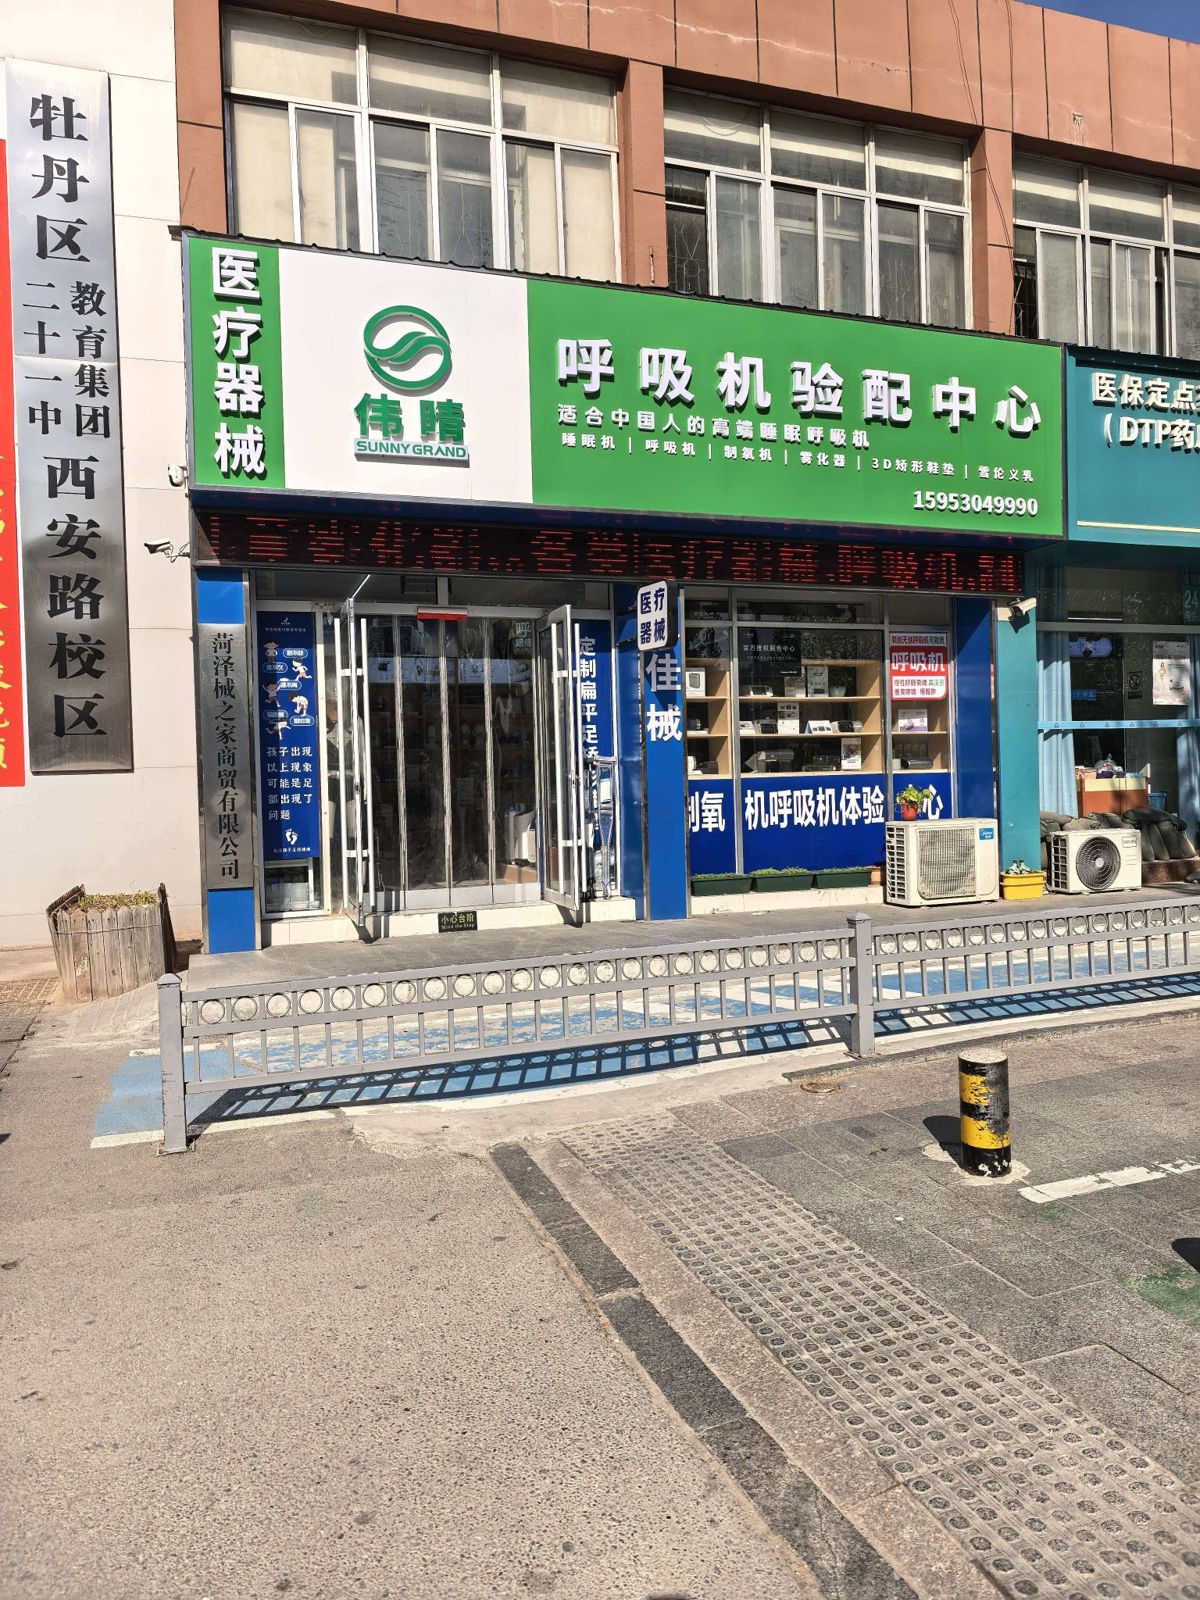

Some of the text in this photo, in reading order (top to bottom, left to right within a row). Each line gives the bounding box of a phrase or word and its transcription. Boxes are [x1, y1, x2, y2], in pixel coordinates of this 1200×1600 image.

[28, 93, 91, 263] 牡丹区
[22, 281, 63, 437] 二十一中
[70, 280, 111, 439] 教育集团
[211, 246, 267, 475] 医疗器械
[557, 337, 1042, 435] 呼吸机验配中心
[1092, 371, 1200, 414] 医保定点
[353, 392, 466, 444] 伟晴
[558, 403, 870, 450] 适合中国人的高端睡眠呼吸机
[1104, 413, 1200, 452] (DTP药
[356, 440, 467, 459] SUNNY GRAND
[645, 439, 696, 457] 呼吸机
[724, 445, 773, 462] 制氧机
[913, 490, 1039, 517] 15953049990
[43, 454, 108, 738] 西安路校区
[640, 587, 666, 615] 医疗
[640, 618, 666, 645] 器械
[891, 651, 945, 672] 呼吸机
[210, 631, 240, 881] 菏泽械之家商贸有限公司
[266, 746, 313, 758] 孩子出现
[267, 762, 313, 773] 以上现象
[267, 778, 313, 789] 可能是足
[268, 793, 313, 805] 部出现了
[268, 810, 291, 821] 问题
[441, 913, 474, 924] 小心台阶
